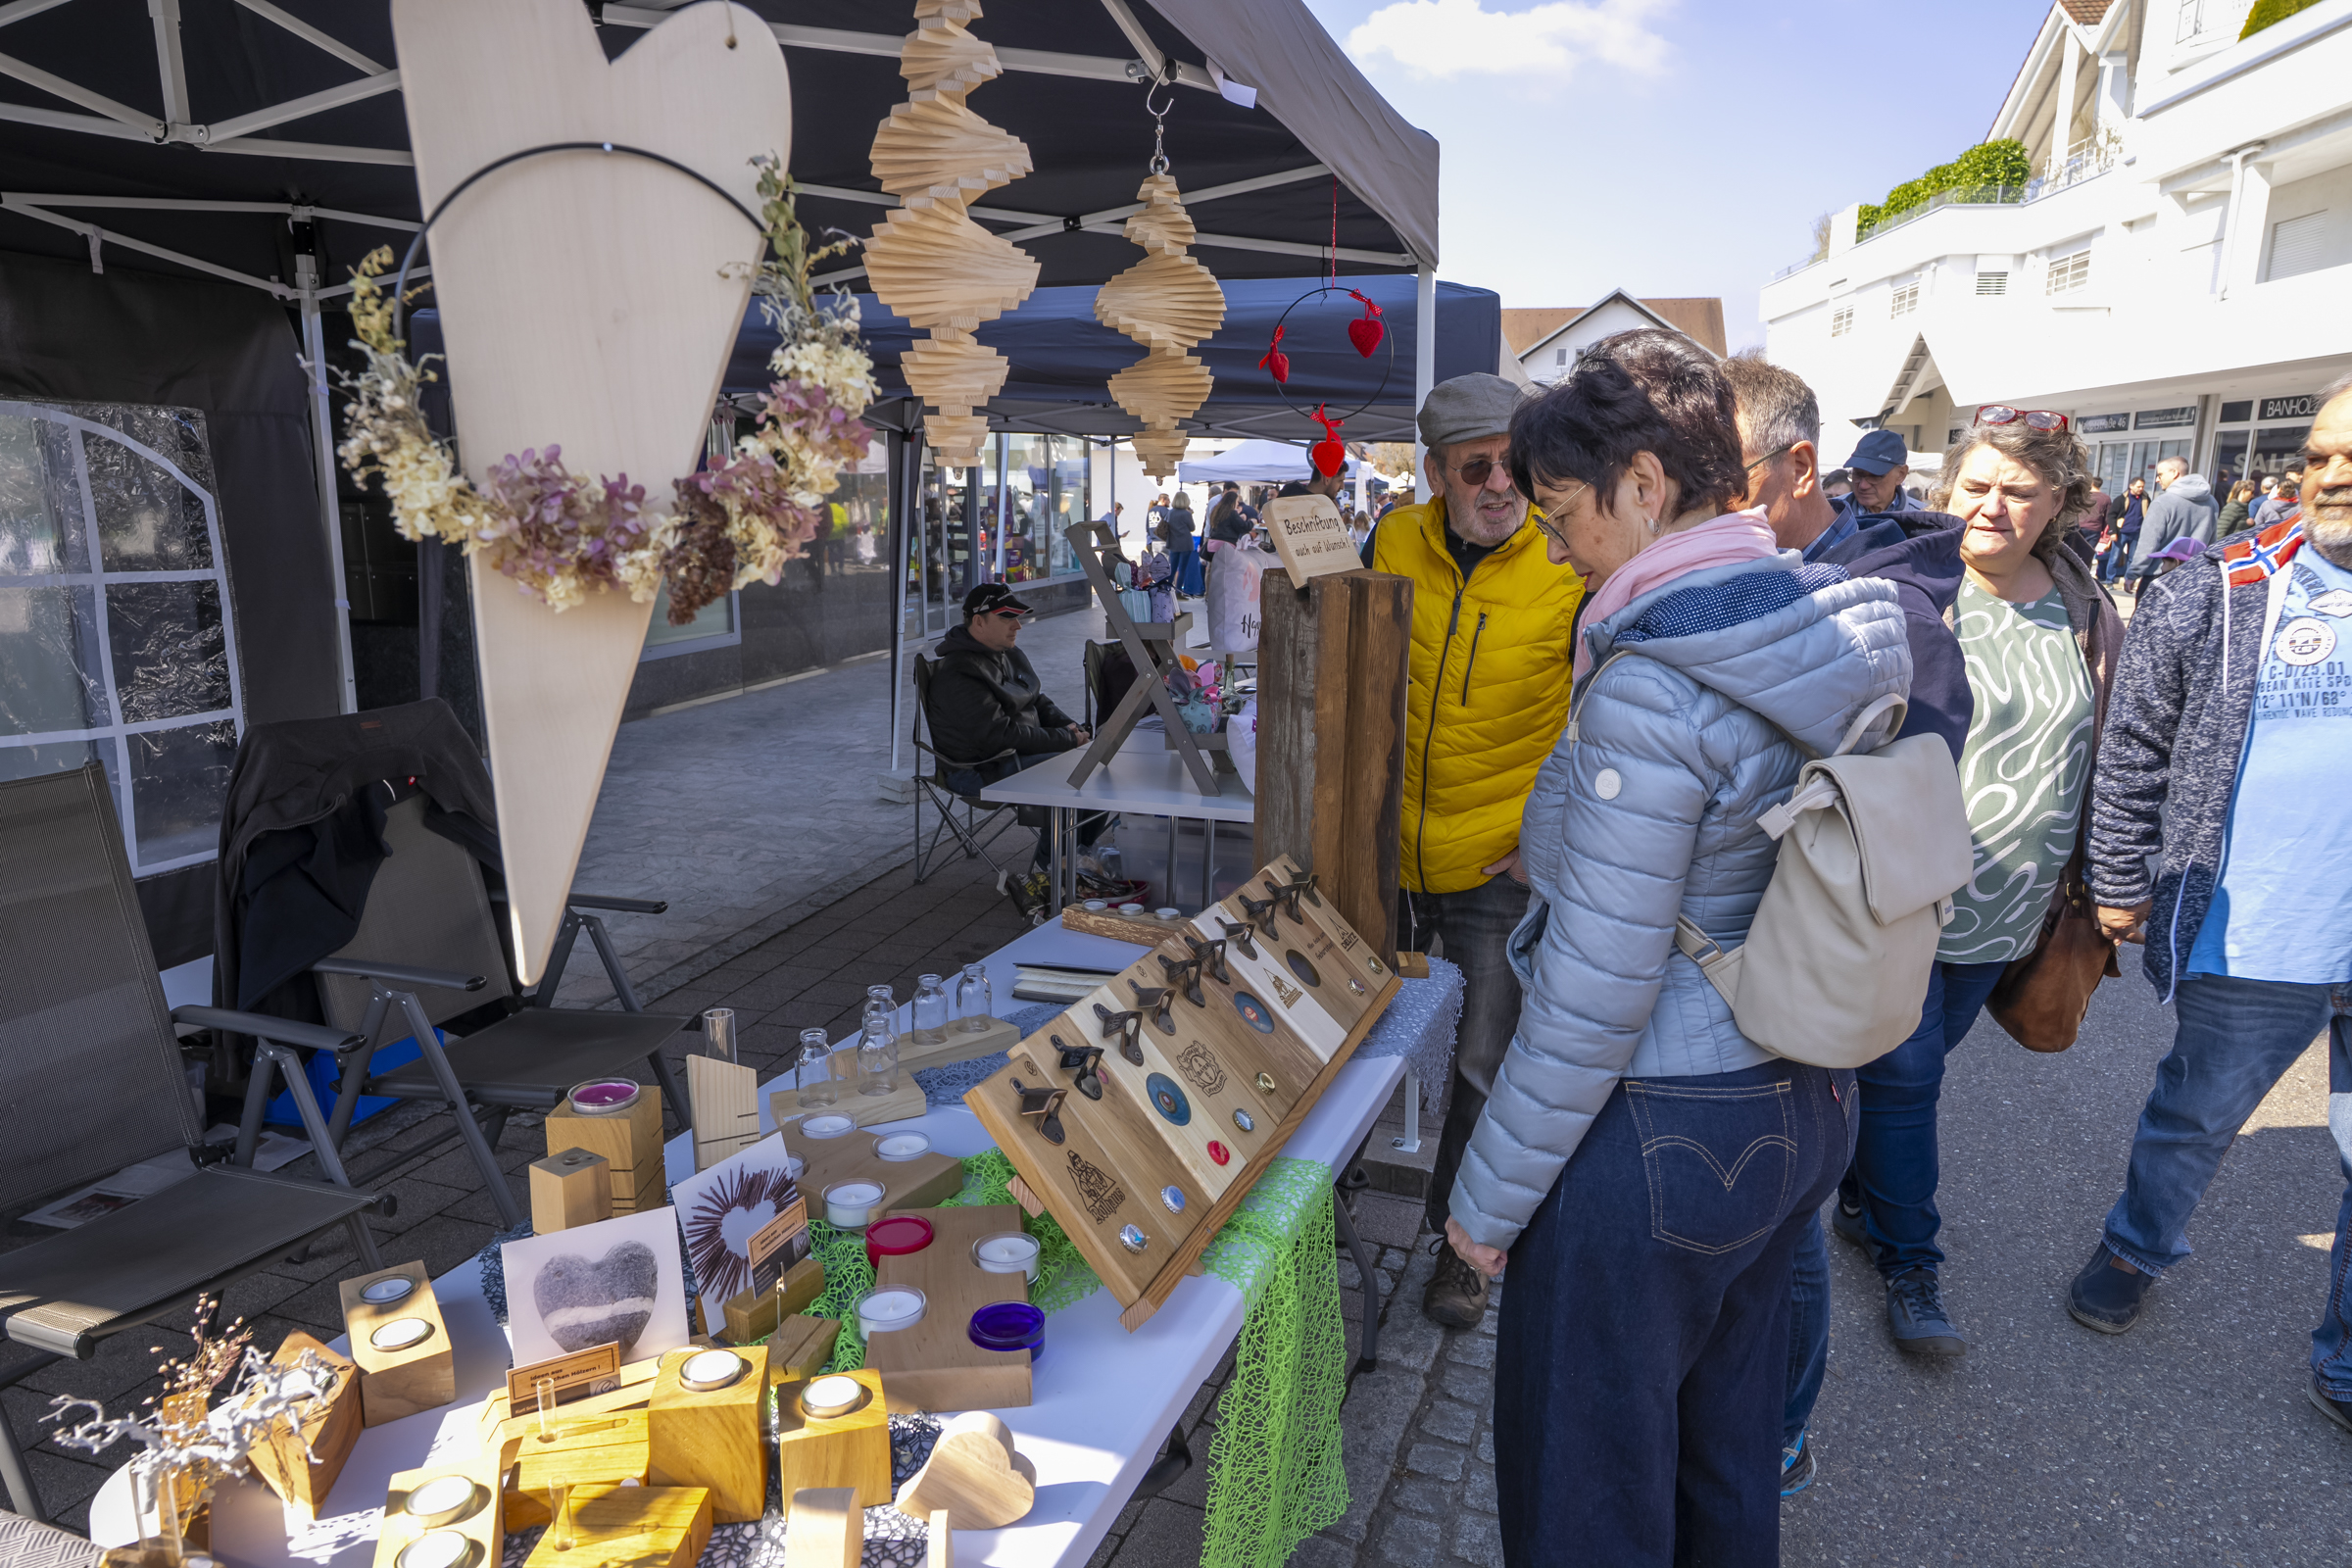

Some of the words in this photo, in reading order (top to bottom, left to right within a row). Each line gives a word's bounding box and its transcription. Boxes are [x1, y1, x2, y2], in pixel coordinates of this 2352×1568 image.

[2117, 416, 2126, 428] 46
[1284, 514, 1341, 535] Beschriftung
[1295, 544, 1311, 557] auch
[1311, 542, 1323, 555] auf
[1341, 931, 1357, 950] DEUTZ
[530, 1372, 550, 1381] Ideen
[571, 1365, 597, 1377] Hölzern
